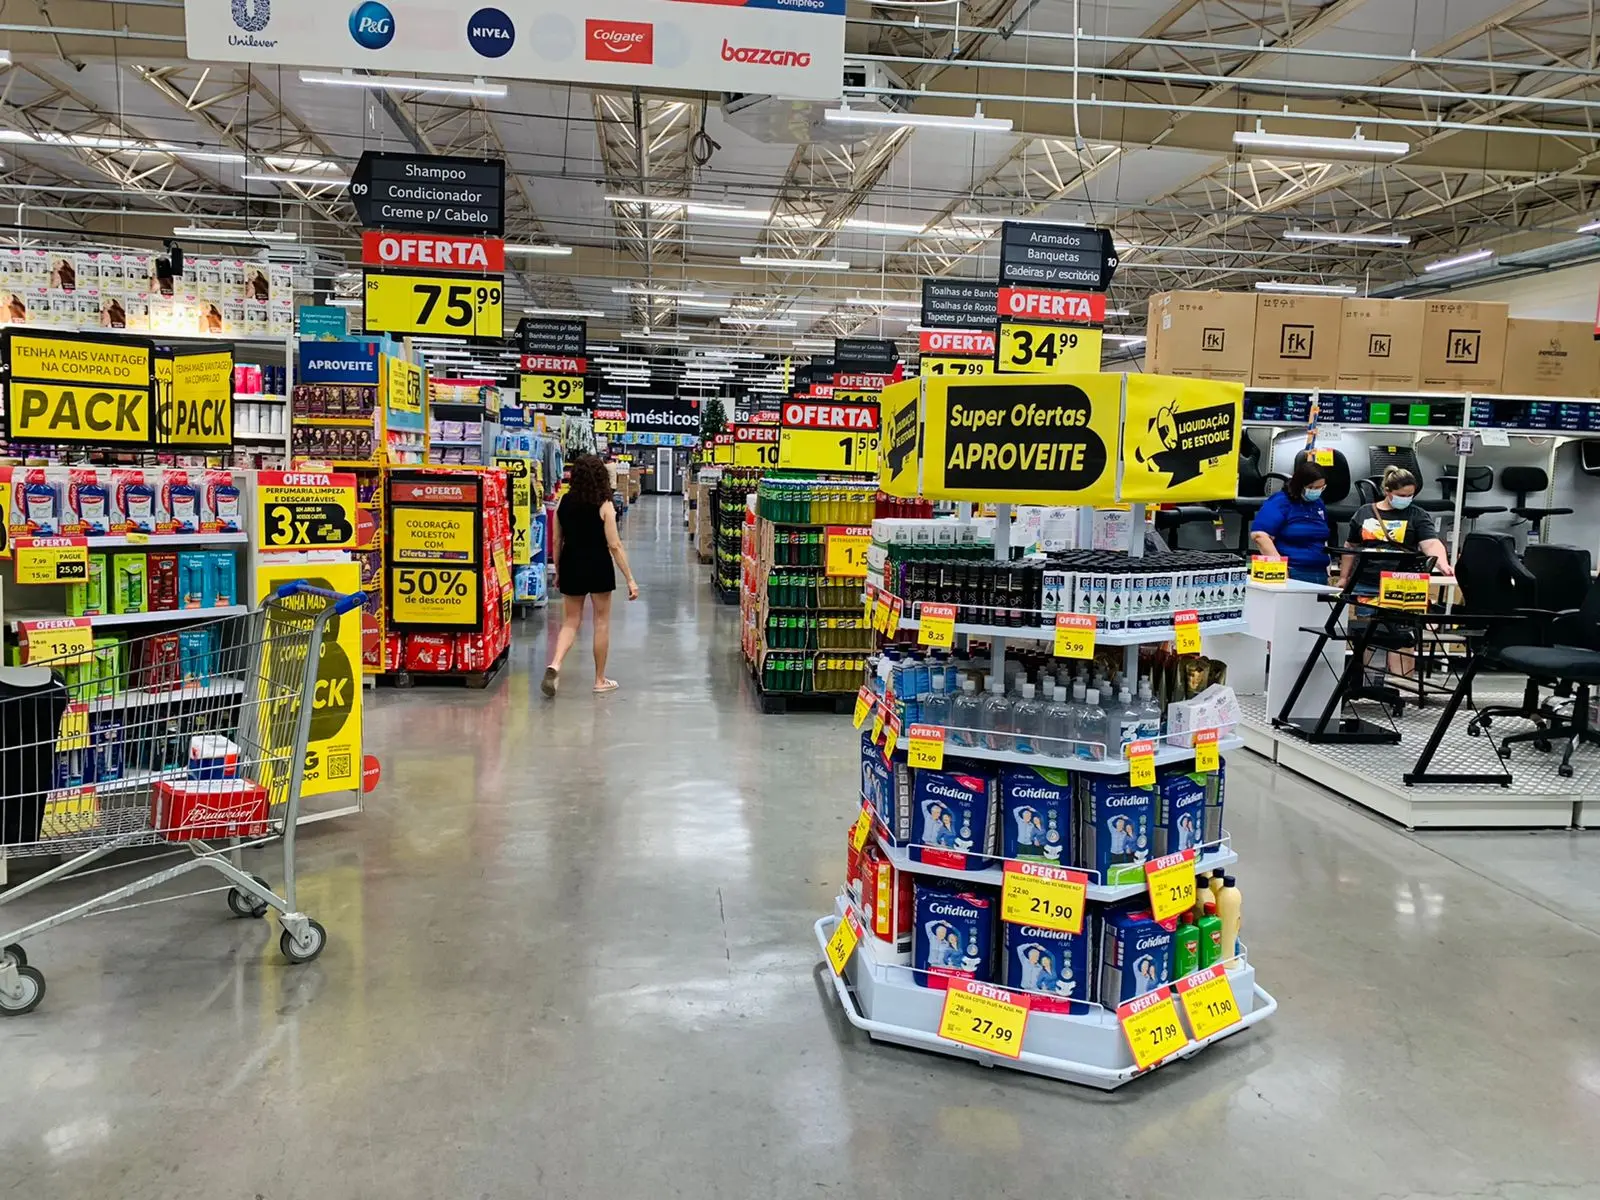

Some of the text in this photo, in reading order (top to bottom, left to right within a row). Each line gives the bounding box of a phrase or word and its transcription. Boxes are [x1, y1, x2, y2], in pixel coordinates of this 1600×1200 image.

[358, 16, 390, 34] P&G
[472, 27, 511, 39] NIVEA
[593, 29, 645, 43] Colgate
[228, 35, 278, 48] Unilever
[721, 38, 811, 67] bozzano
[405, 164, 466, 181] Shampoo
[352, 183, 368, 196] 09
[388, 185, 482, 203] Condicionador
[381, 205, 489, 225] Creme p/ Cabelo
[1030, 232, 1080, 246] Aramados
[378, 238, 489, 266] OFERTA
[1028, 249, 1080, 264] Banquetas
[1108, 258, 1117, 267] 10
[1005, 264, 1100, 281] Cadeiras p/ escritório
[367, 281, 379, 291] R$
[930, 286, 999, 299] Toalhas de Banho
[931, 301, 997, 312] Toalhas de Rosto
[1009, 293, 1092, 317] OFERTA
[927, 312, 955, 324] Tapetes
[956, 314, 966, 325] p/
[1002, 328, 1010, 337] R$
[1207, 333, 1219, 346] fk
[929, 334, 994, 351] OFERTA
[1288, 333, 1306, 351] fk
[1374, 339, 1386, 351] fk
[1454, 338, 1472, 355] fk
[16, 346, 54, 358] TENHA
[59, 350, 88, 361] MAIS
[41, 361, 130, 377] NA COMPRA DO
[308, 360, 373, 371] APROVEITE
[526, 357, 578, 370] OFERTA
[840, 375, 885, 387] OFERTA
[19, 389, 143, 431] PACK
[786, 405, 872, 428] OFERTA
[175, 399, 226, 436] PACK
[950, 404, 1087, 432] Super Ofertas
[1178, 412, 1230, 436] LIQUIDAÇÃO
[1181, 430, 1230, 450] DE ESTOQUE
[947, 443, 1087, 471] APROVEITE
[282, 474, 330, 485] OFERTA
[425, 487, 463, 495] OFERTA
[406, 520, 460, 531] COLORAÇÃO
[411, 531, 455, 539] KOLESTON
[33, 538, 72, 547] OFERTA
[401, 550, 427, 558] Oferta
[845, 548, 867, 567] 1,5
[59, 565, 84, 574] 25,99
[398, 570, 467, 597] 50%
[306, 596, 326, 609] MAIS
[405, 596, 461, 605] de desconto
[923, 606, 953, 615] OFERTA
[1175, 613, 1196, 622] OFERTA
[37, 620, 76, 629] OFERTA
[1059, 616, 1092, 626] OFERTA
[928, 631, 944, 640] 8,25
[51, 643, 84, 655] 13,99
[1065, 643, 1084, 652] 5,99
[1183, 639, 1195, 647] 5,99
[911, 728, 941, 737] OFERTA
[1197, 732, 1216, 741] OFERTA
[1130, 745, 1152, 753] OFERTA
[917, 753, 936, 762] 12,90
[926, 782, 973, 801] Cotidian
[1012, 787, 1060, 800] Cotidian
[1105, 795, 1149, 807] Cotidian
[1176, 791, 1203, 808] Cotidian
[188, 808, 252, 821] Budweiser
[1157, 853, 1184, 870] OFERTA
[1021, 864, 1067, 881] OFERTA
[1170, 884, 1193, 901] 21,90
[929, 902, 978, 919] Cotidian
[1030, 897, 1072, 919] 21,90
[1136, 934, 1170, 950] Cotidian
[1188, 969, 1216, 987] OFERTA
[967, 982, 1011, 1003] OFERTA
[1130, 993, 1161, 1013] OFERTA
[1207, 1000, 1232, 1017] 11,90
[971, 1017, 1012, 1041] 27,99
[1150, 1024, 1176, 1045] 27,99
